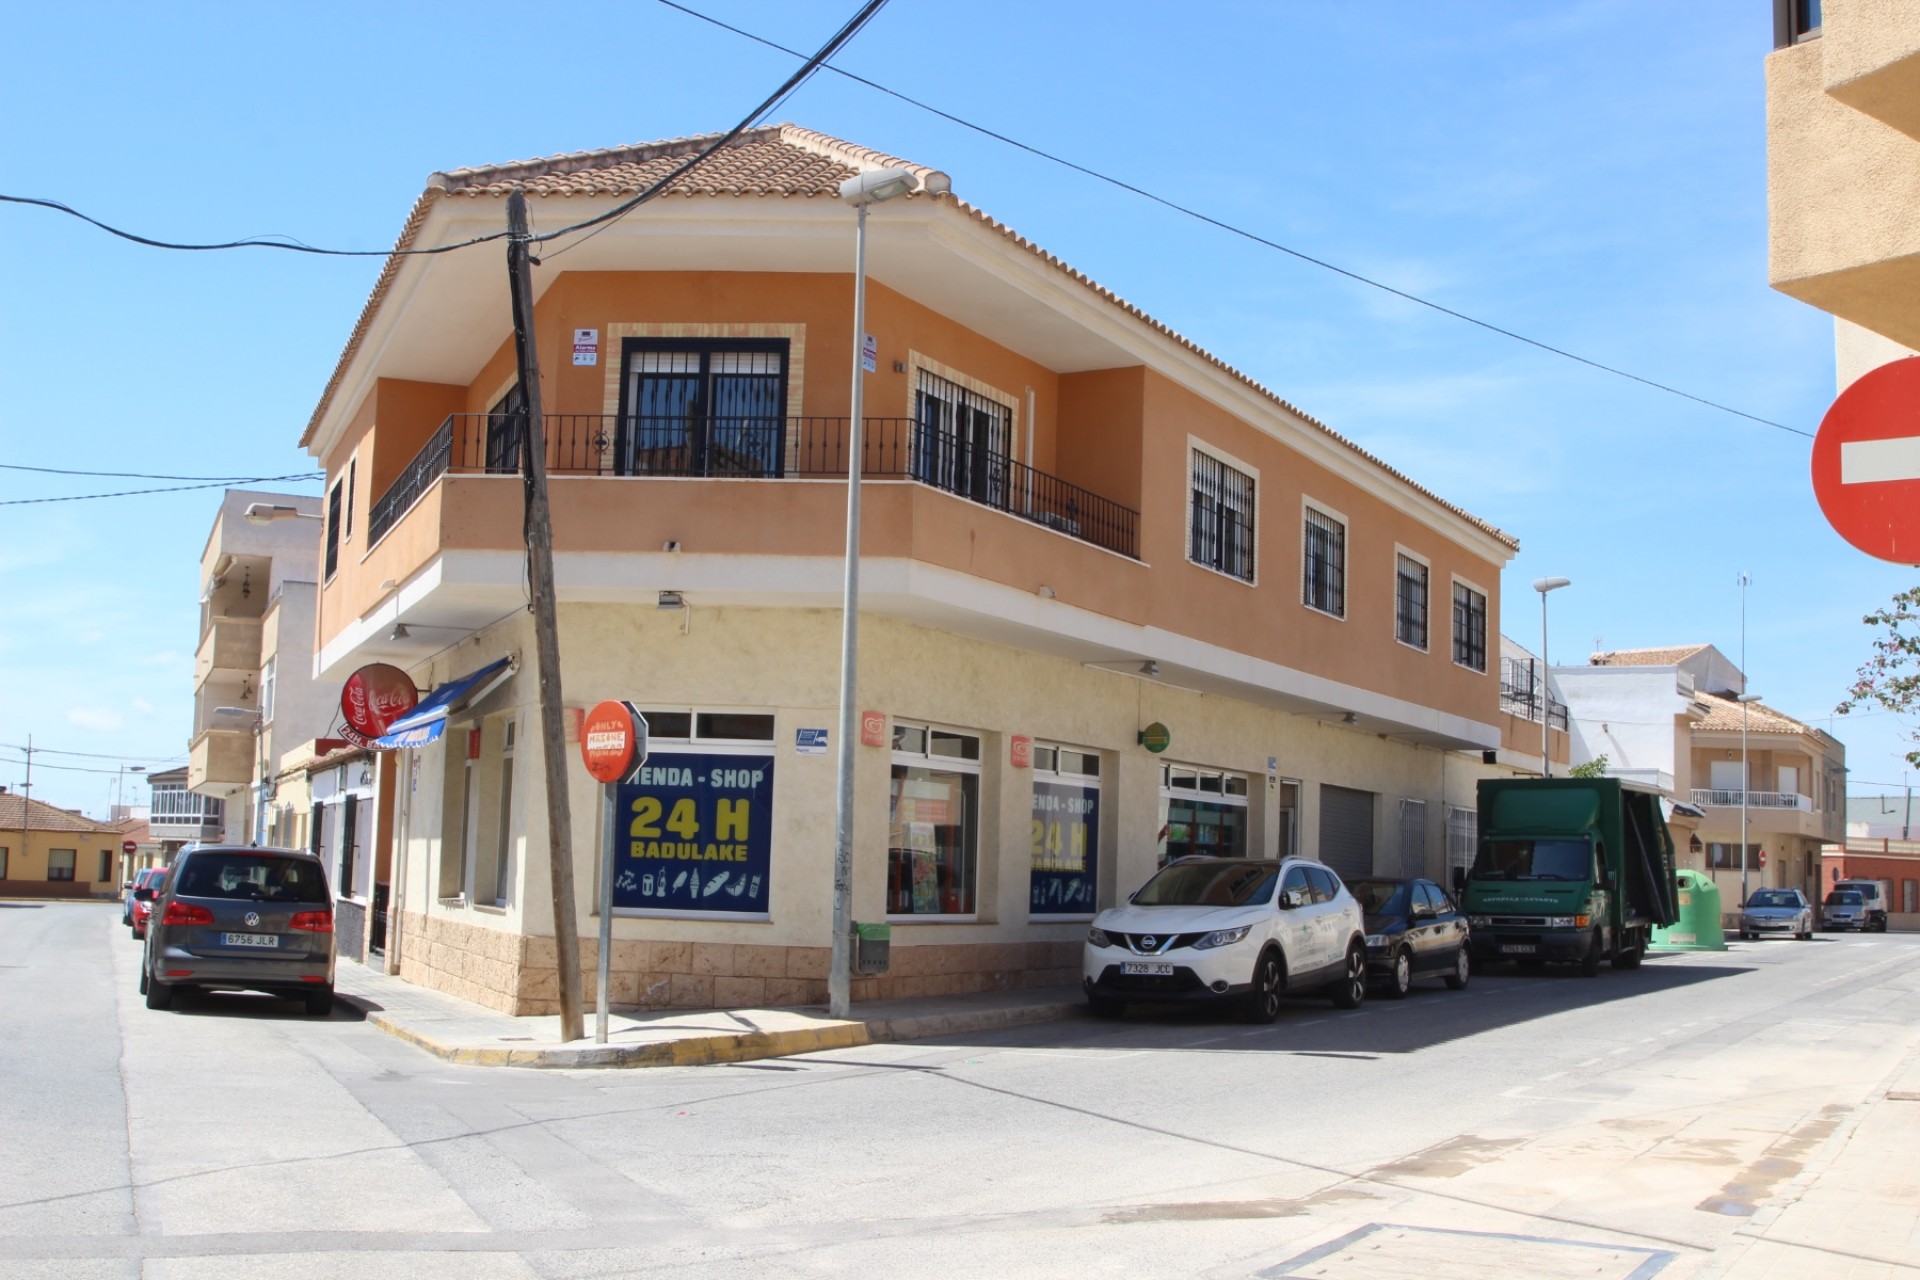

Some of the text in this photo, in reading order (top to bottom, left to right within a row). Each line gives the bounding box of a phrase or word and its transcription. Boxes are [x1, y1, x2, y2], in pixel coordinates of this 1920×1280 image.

[633, 767, 693, 787] IENDA
[710, 768, 764, 789] SHOP
[1033, 794, 1059, 812] ENDA
[1067, 797, 1095, 815] SHOP
[630, 796, 750, 841] 24 H
[1032, 819, 1088, 858] 24 H
[630, 841, 748, 862] BADULAKE
[227, 934, 275, 946] 6756 JLR
[1127, 963, 1170, 973] 7328 JCC
